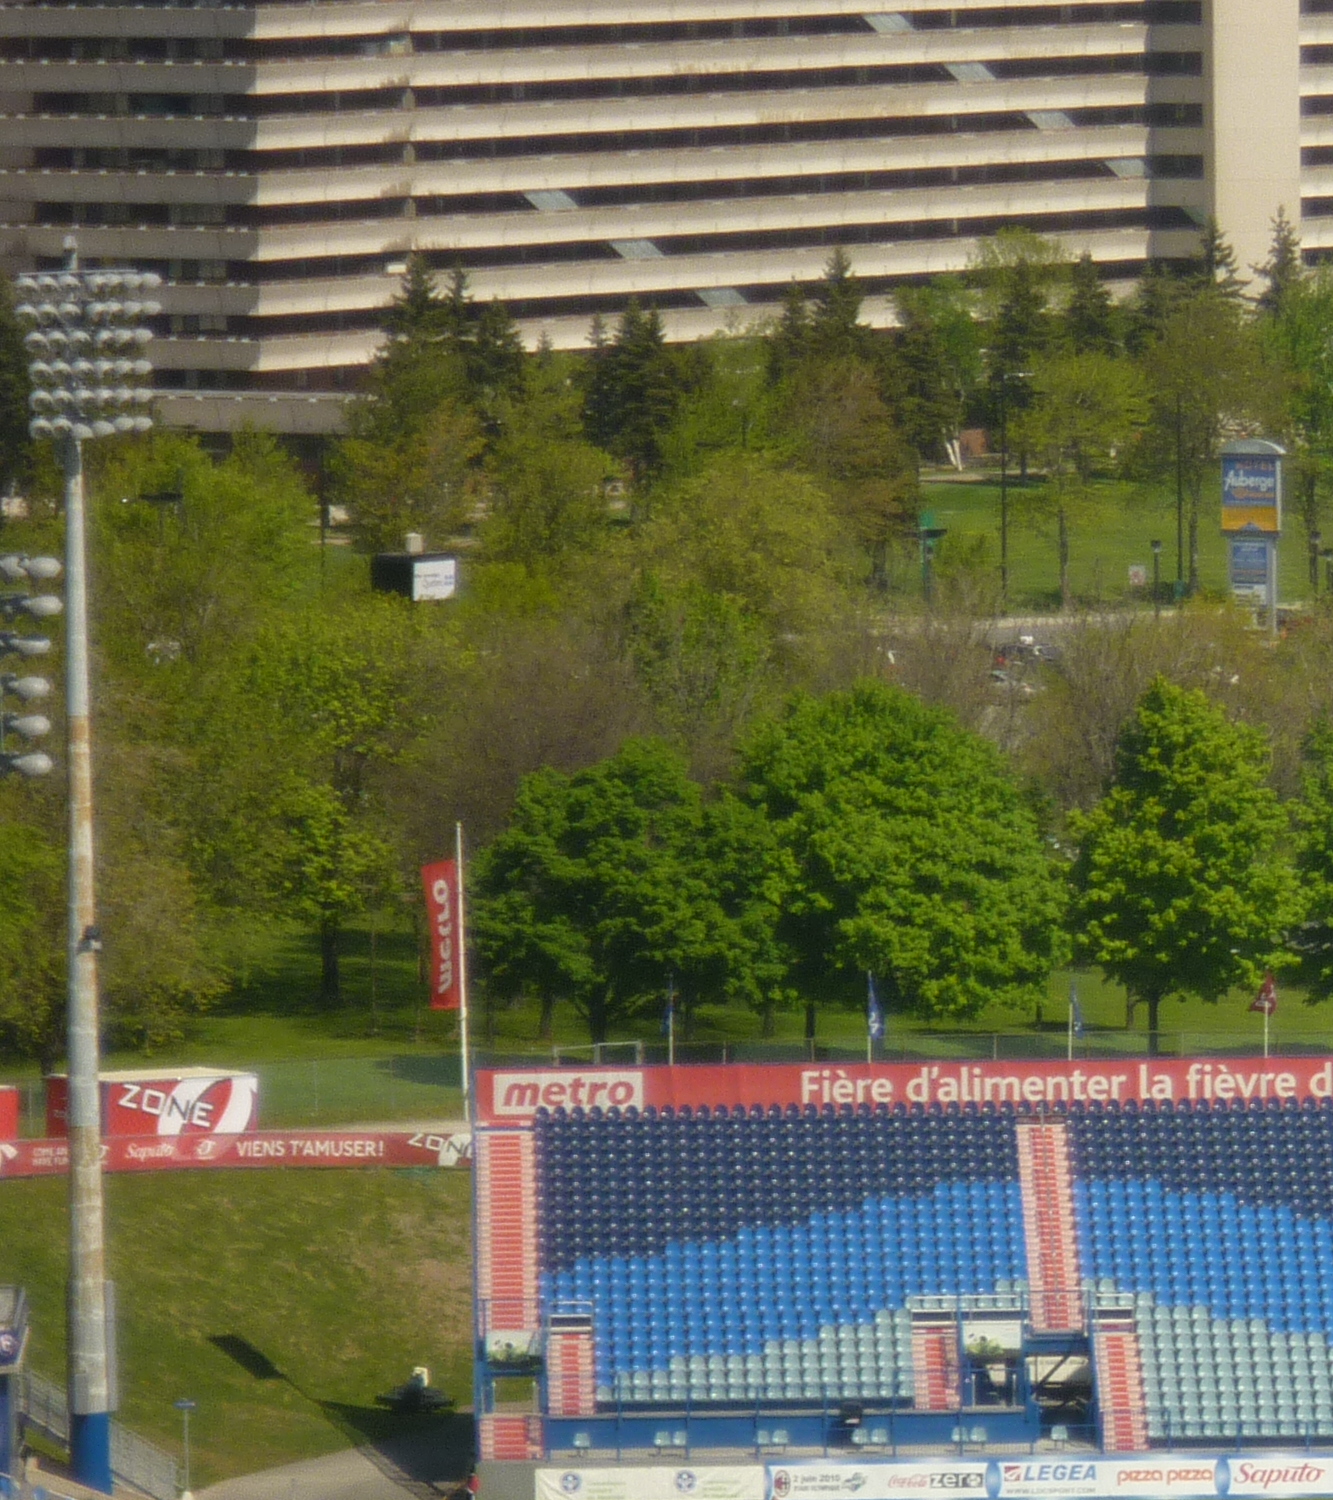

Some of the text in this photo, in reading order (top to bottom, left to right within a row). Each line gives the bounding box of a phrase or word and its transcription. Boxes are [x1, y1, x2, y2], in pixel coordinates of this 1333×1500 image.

[1224, 470, 1275, 492] Auberge
[502, 1076, 635, 1107] metro
[800, 1069, 893, 1103] Fière
[906, 1063, 1127, 1102] d'alimenter
[1138, 1063, 1170, 1100] la
[1185, 1060, 1296, 1099] fièvre
[118, 1083, 214, 1128] ZONE
[236, 1141, 285, 1157] VIENS
[930, 1473, 984, 1488] zero
[1024, 1464, 1098, 1482] LEGEA
[1117, 1468, 1213, 1486] pizza pizza
[1234, 1462, 1325, 1489] Saputo
